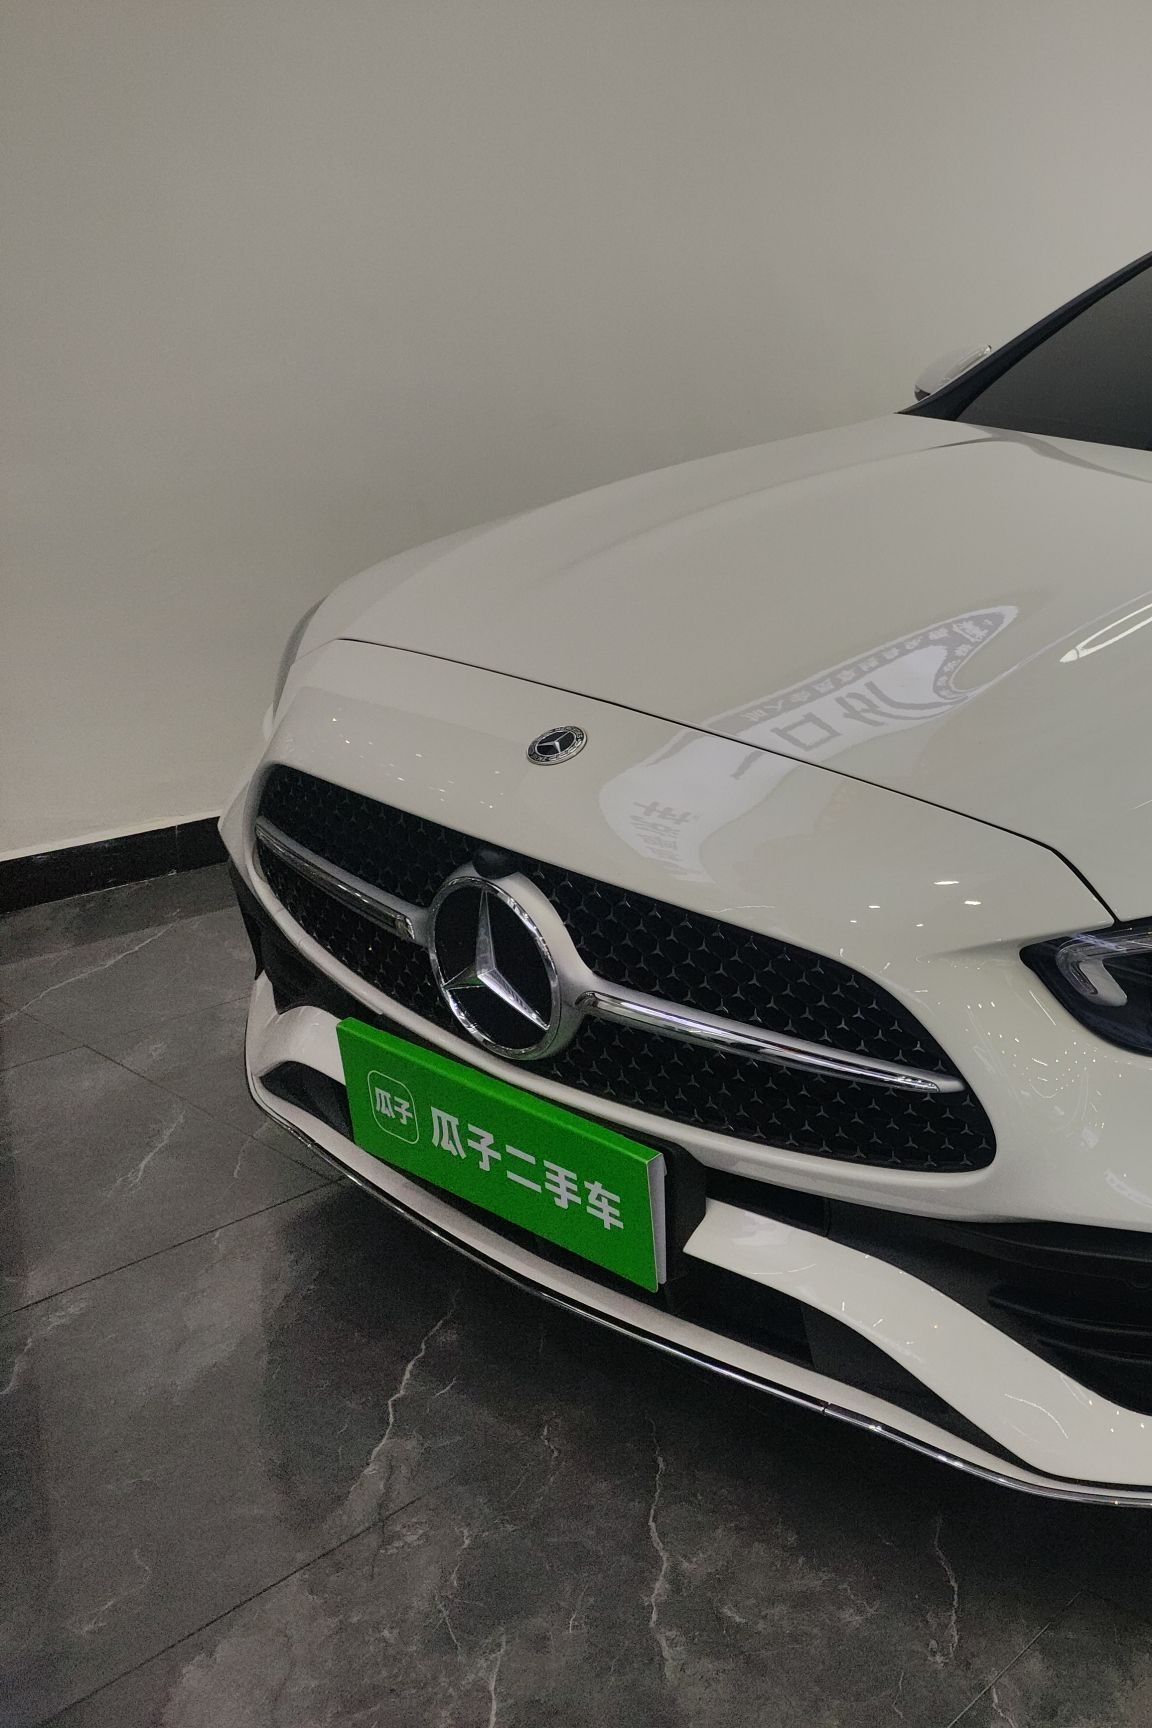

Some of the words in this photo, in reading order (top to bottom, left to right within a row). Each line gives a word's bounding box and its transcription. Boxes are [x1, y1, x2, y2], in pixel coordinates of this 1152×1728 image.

[374, 1086, 413, 1125] 瓜子
[431, 1106, 624, 1230] 瓜子二手车
